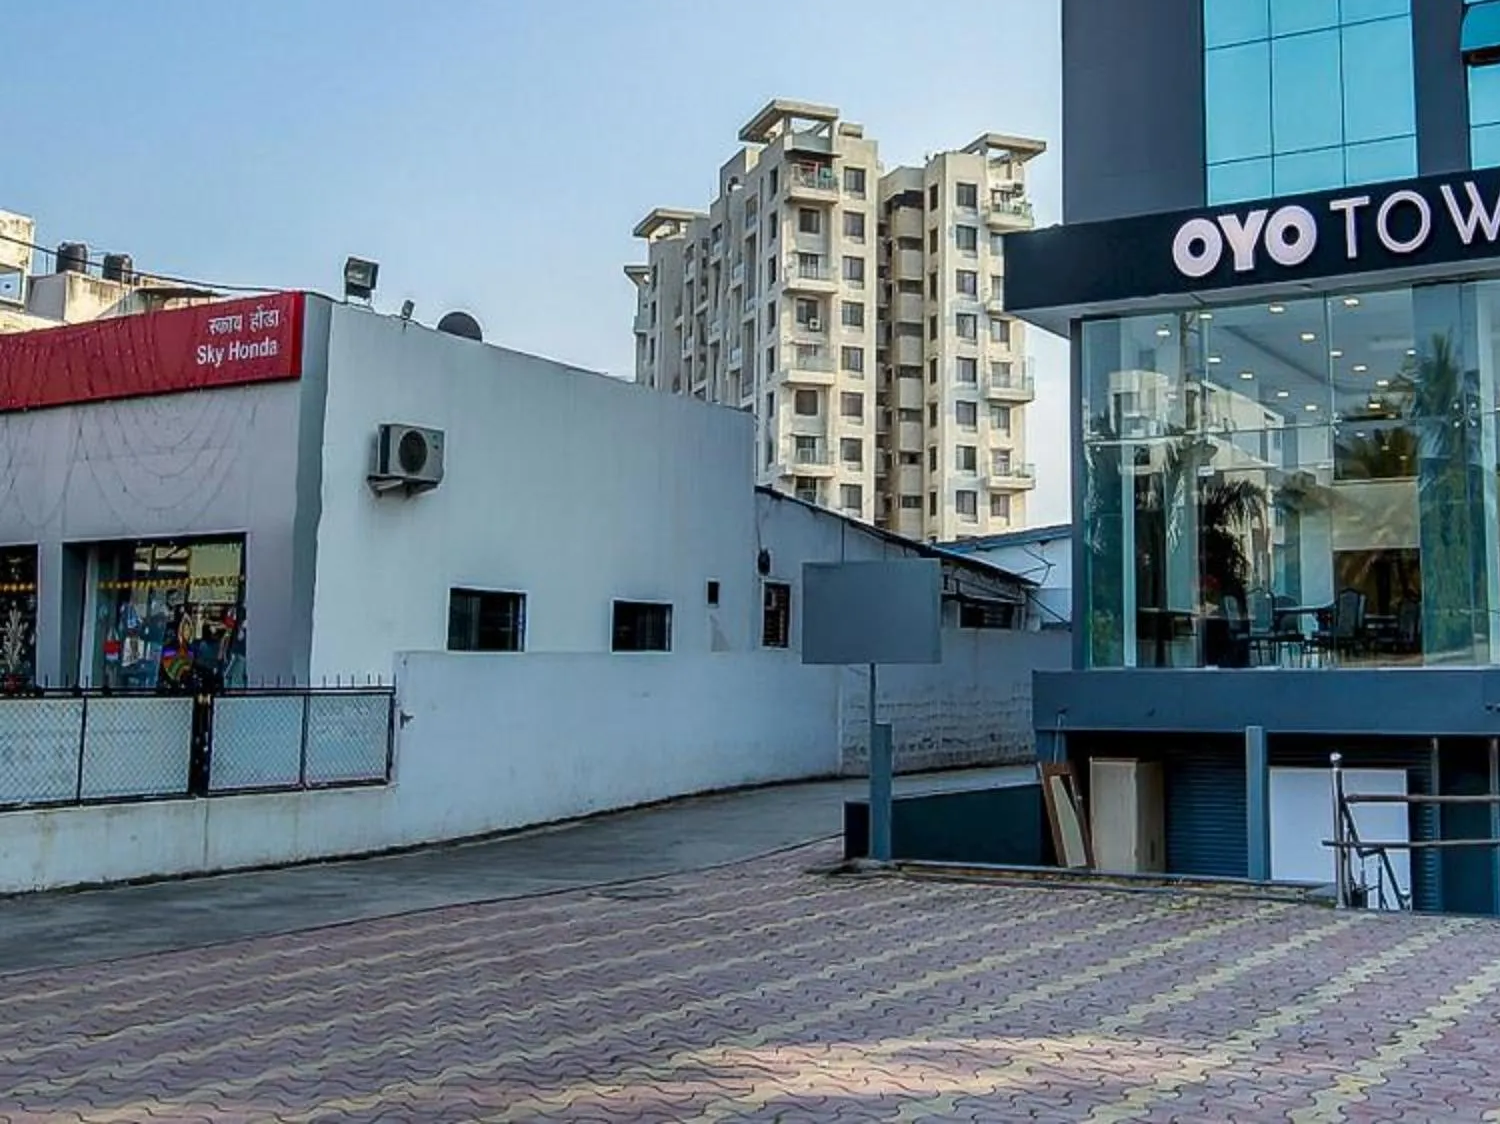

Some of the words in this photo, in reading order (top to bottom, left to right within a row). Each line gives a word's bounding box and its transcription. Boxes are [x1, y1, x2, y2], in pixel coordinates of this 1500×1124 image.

[1173, 204, 1317, 278] OYO
[197, 344, 225, 368] Sky
[227, 336, 278, 361] Honda
